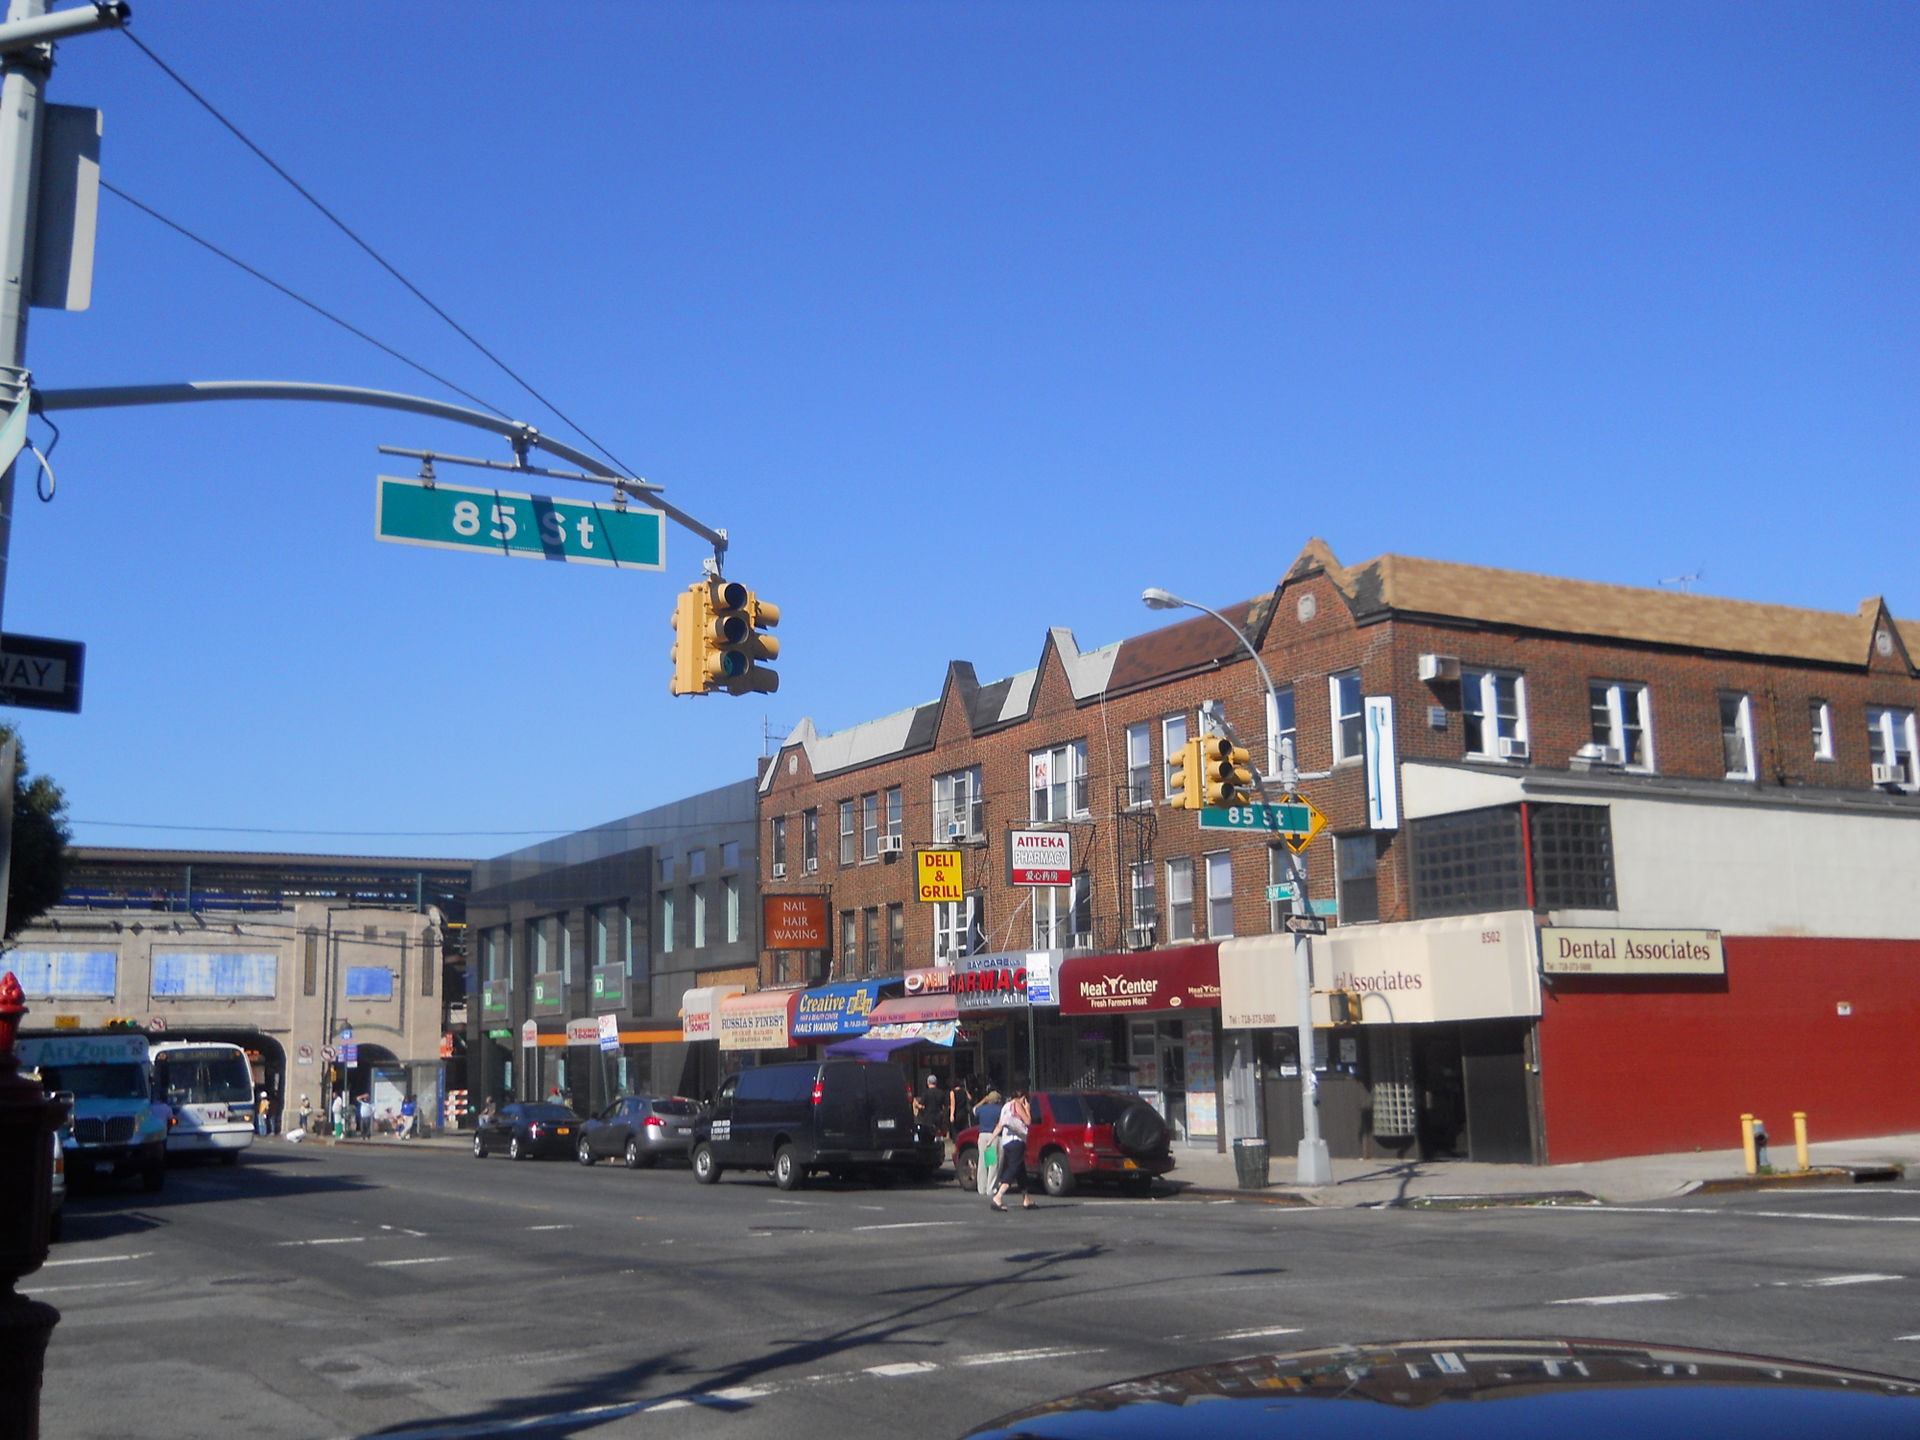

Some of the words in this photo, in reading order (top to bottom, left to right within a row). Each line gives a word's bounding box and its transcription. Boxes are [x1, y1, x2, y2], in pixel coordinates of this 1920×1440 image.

[452, 501, 517, 540] 85
[540, 511, 595, 549] St
[1228, 807, 1254, 825] 85
[1263, 809, 1284, 826] St
[925, 854, 954, 867] DELI
[1014, 850, 1067, 865] PHARMACY
[934, 870, 945, 882] &
[921, 885, 960, 898] GRILL
[783, 901, 807, 911] NAIL
[782, 916, 808, 926] HAIR
[773, 929, 818, 940] WAXING
[1481, 931, 1501, 944] 8502
[1559, 936, 1616, 959] Dental
[1624, 938, 1710, 961] Associates
[968, 960, 982, 970] BAY
[984, 958, 1009, 968] CARE
[1080, 981, 1107, 997] Meat
[1120, 979, 1158, 994] Center
[1350, 971, 1423, 992] Associates
[800, 993, 845, 1012] Creative
[1090, 999, 1107, 1008] Fresh
[1108, 998, 1132, 1007] Farmers
[1132, 997, 1147, 1006] Meat
[755, 1015, 784, 1027] FINEST
[795, 1023, 812, 1033] NAILS
[813, 1022, 838, 1032] WAXING
